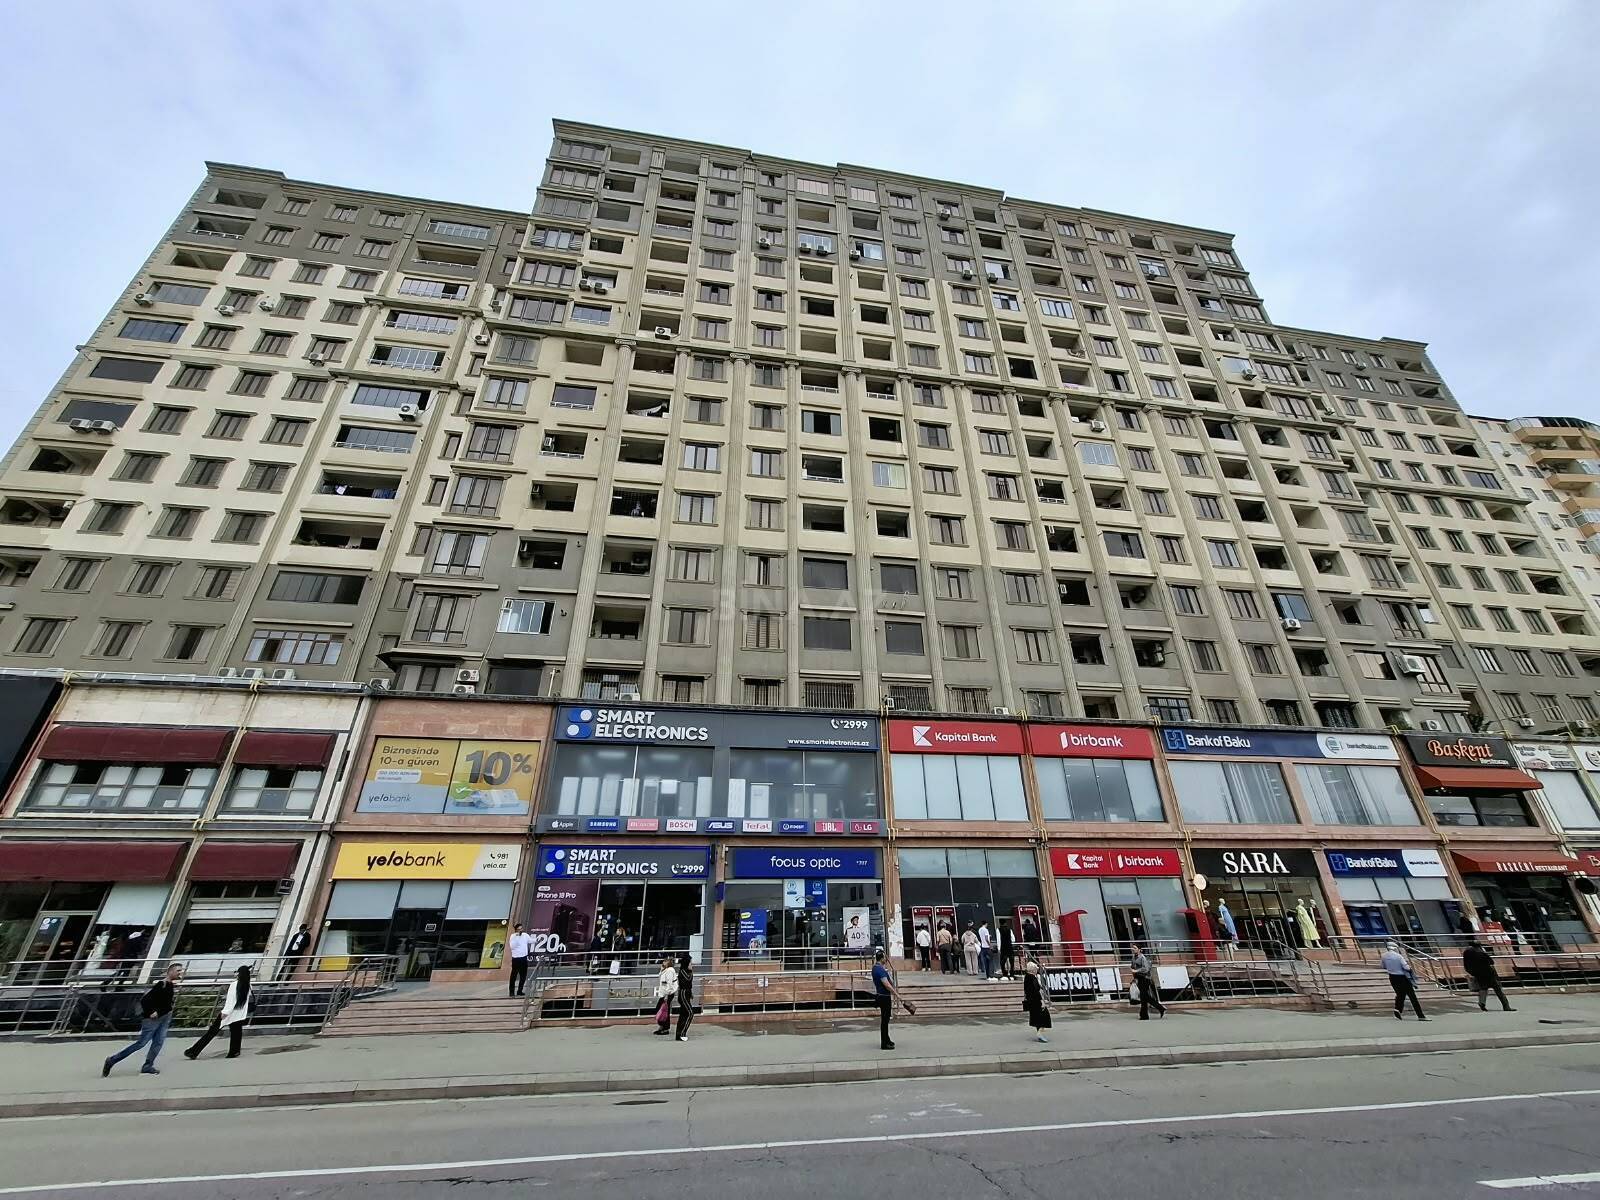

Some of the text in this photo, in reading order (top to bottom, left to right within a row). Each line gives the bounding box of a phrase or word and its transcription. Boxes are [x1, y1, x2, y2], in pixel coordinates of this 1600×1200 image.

[596, 709, 655, 724] SMART
[595, 724, 708, 741] ELECTRONICS
[935, 732, 997, 743] Kapital Bank
[787, 738, 870, 747] www.smartelectronics.az
[1069, 733, 1124, 748] birbank
[382, 745, 440, 755] Biznesində
[1427, 738, 1493, 762] Başkent
[465, 750, 532, 786] 10%
[368, 793, 413, 804] yelobank
[558, 821, 574, 829] Apple
[745, 822, 770, 830] Tefal
[863, 823, 873, 831] LG
[367, 851, 446, 871] yelobank
[569, 849, 617, 861] SMART
[1081, 854, 1104, 862] Kapital
[1124, 855, 1164, 867] birbank
[482, 861, 508, 870] yelo.az
[566, 862, 658, 875] ELECTRONICS
[770, 855, 841, 870] focus optic
[1222, 852, 1290, 874] SARA
